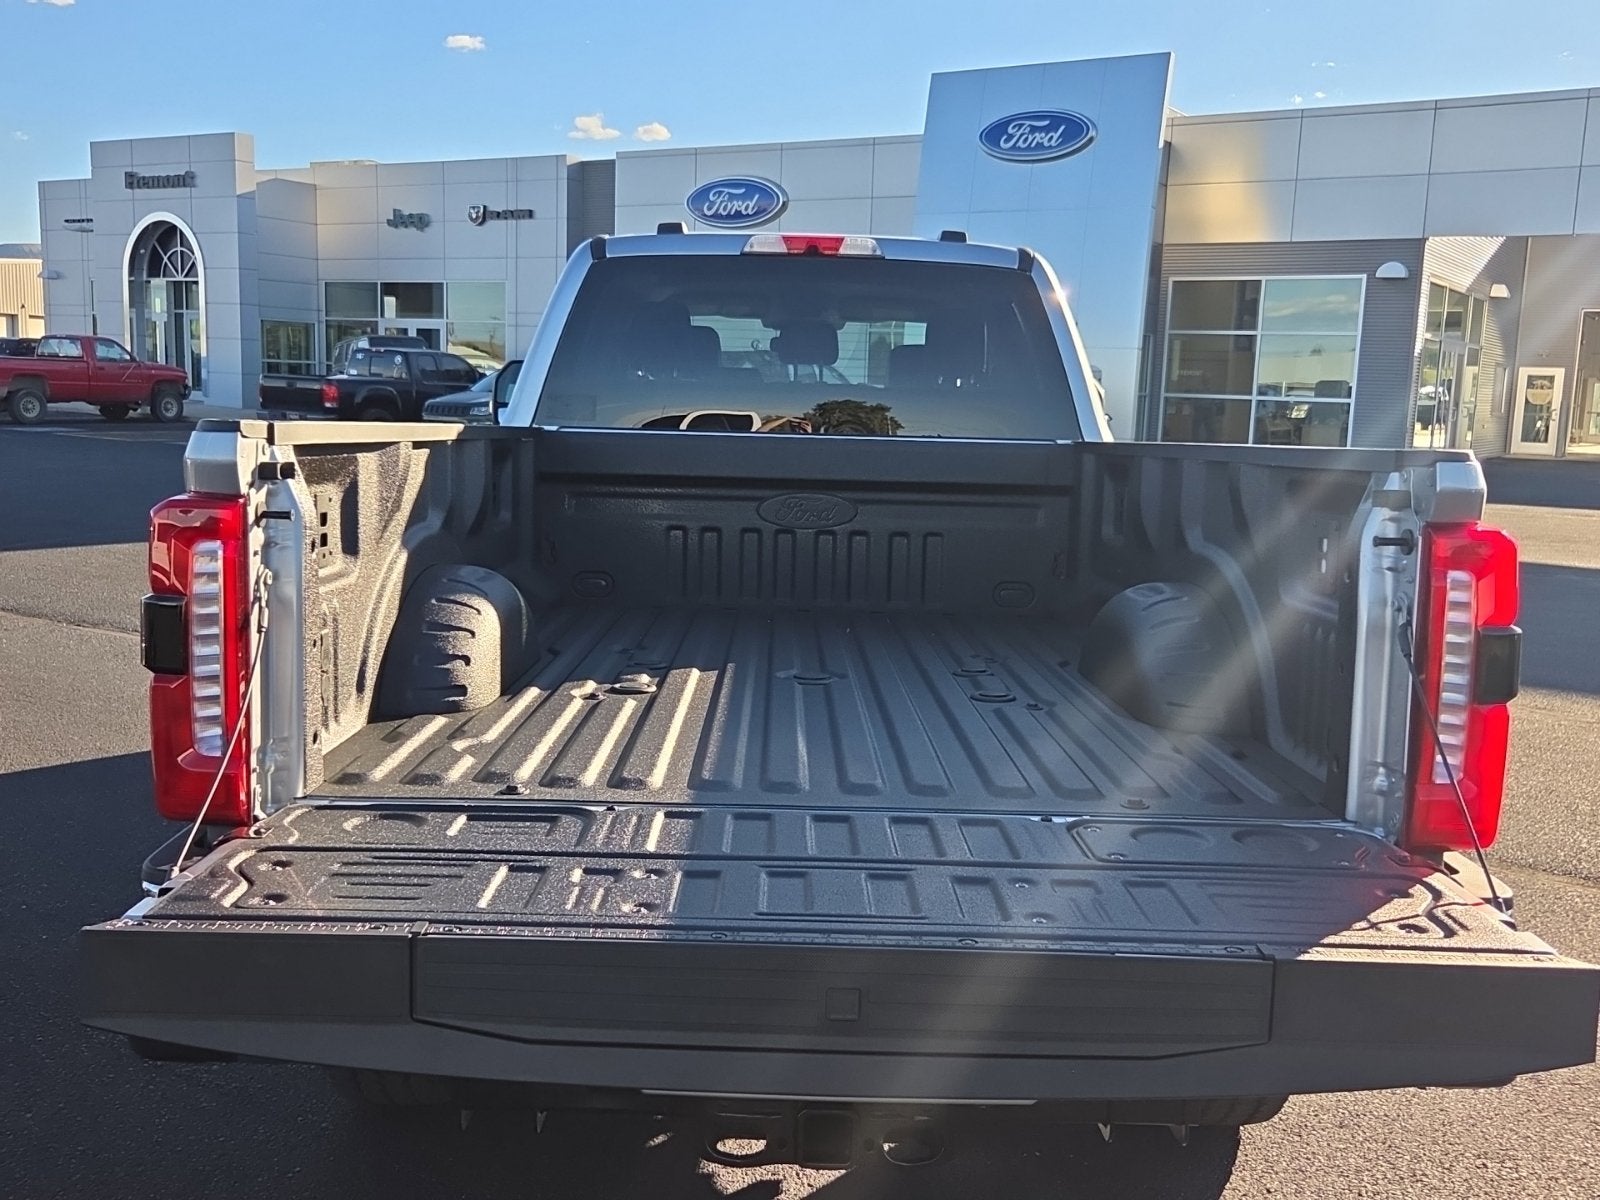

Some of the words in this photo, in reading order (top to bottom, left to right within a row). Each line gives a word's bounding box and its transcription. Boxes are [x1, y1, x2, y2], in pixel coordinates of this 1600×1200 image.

[1000, 120, 1066, 149] Ford
[703, 188, 760, 216] Ford
[386, 208, 431, 232] Jeep
[775, 497, 838, 523] Ford
